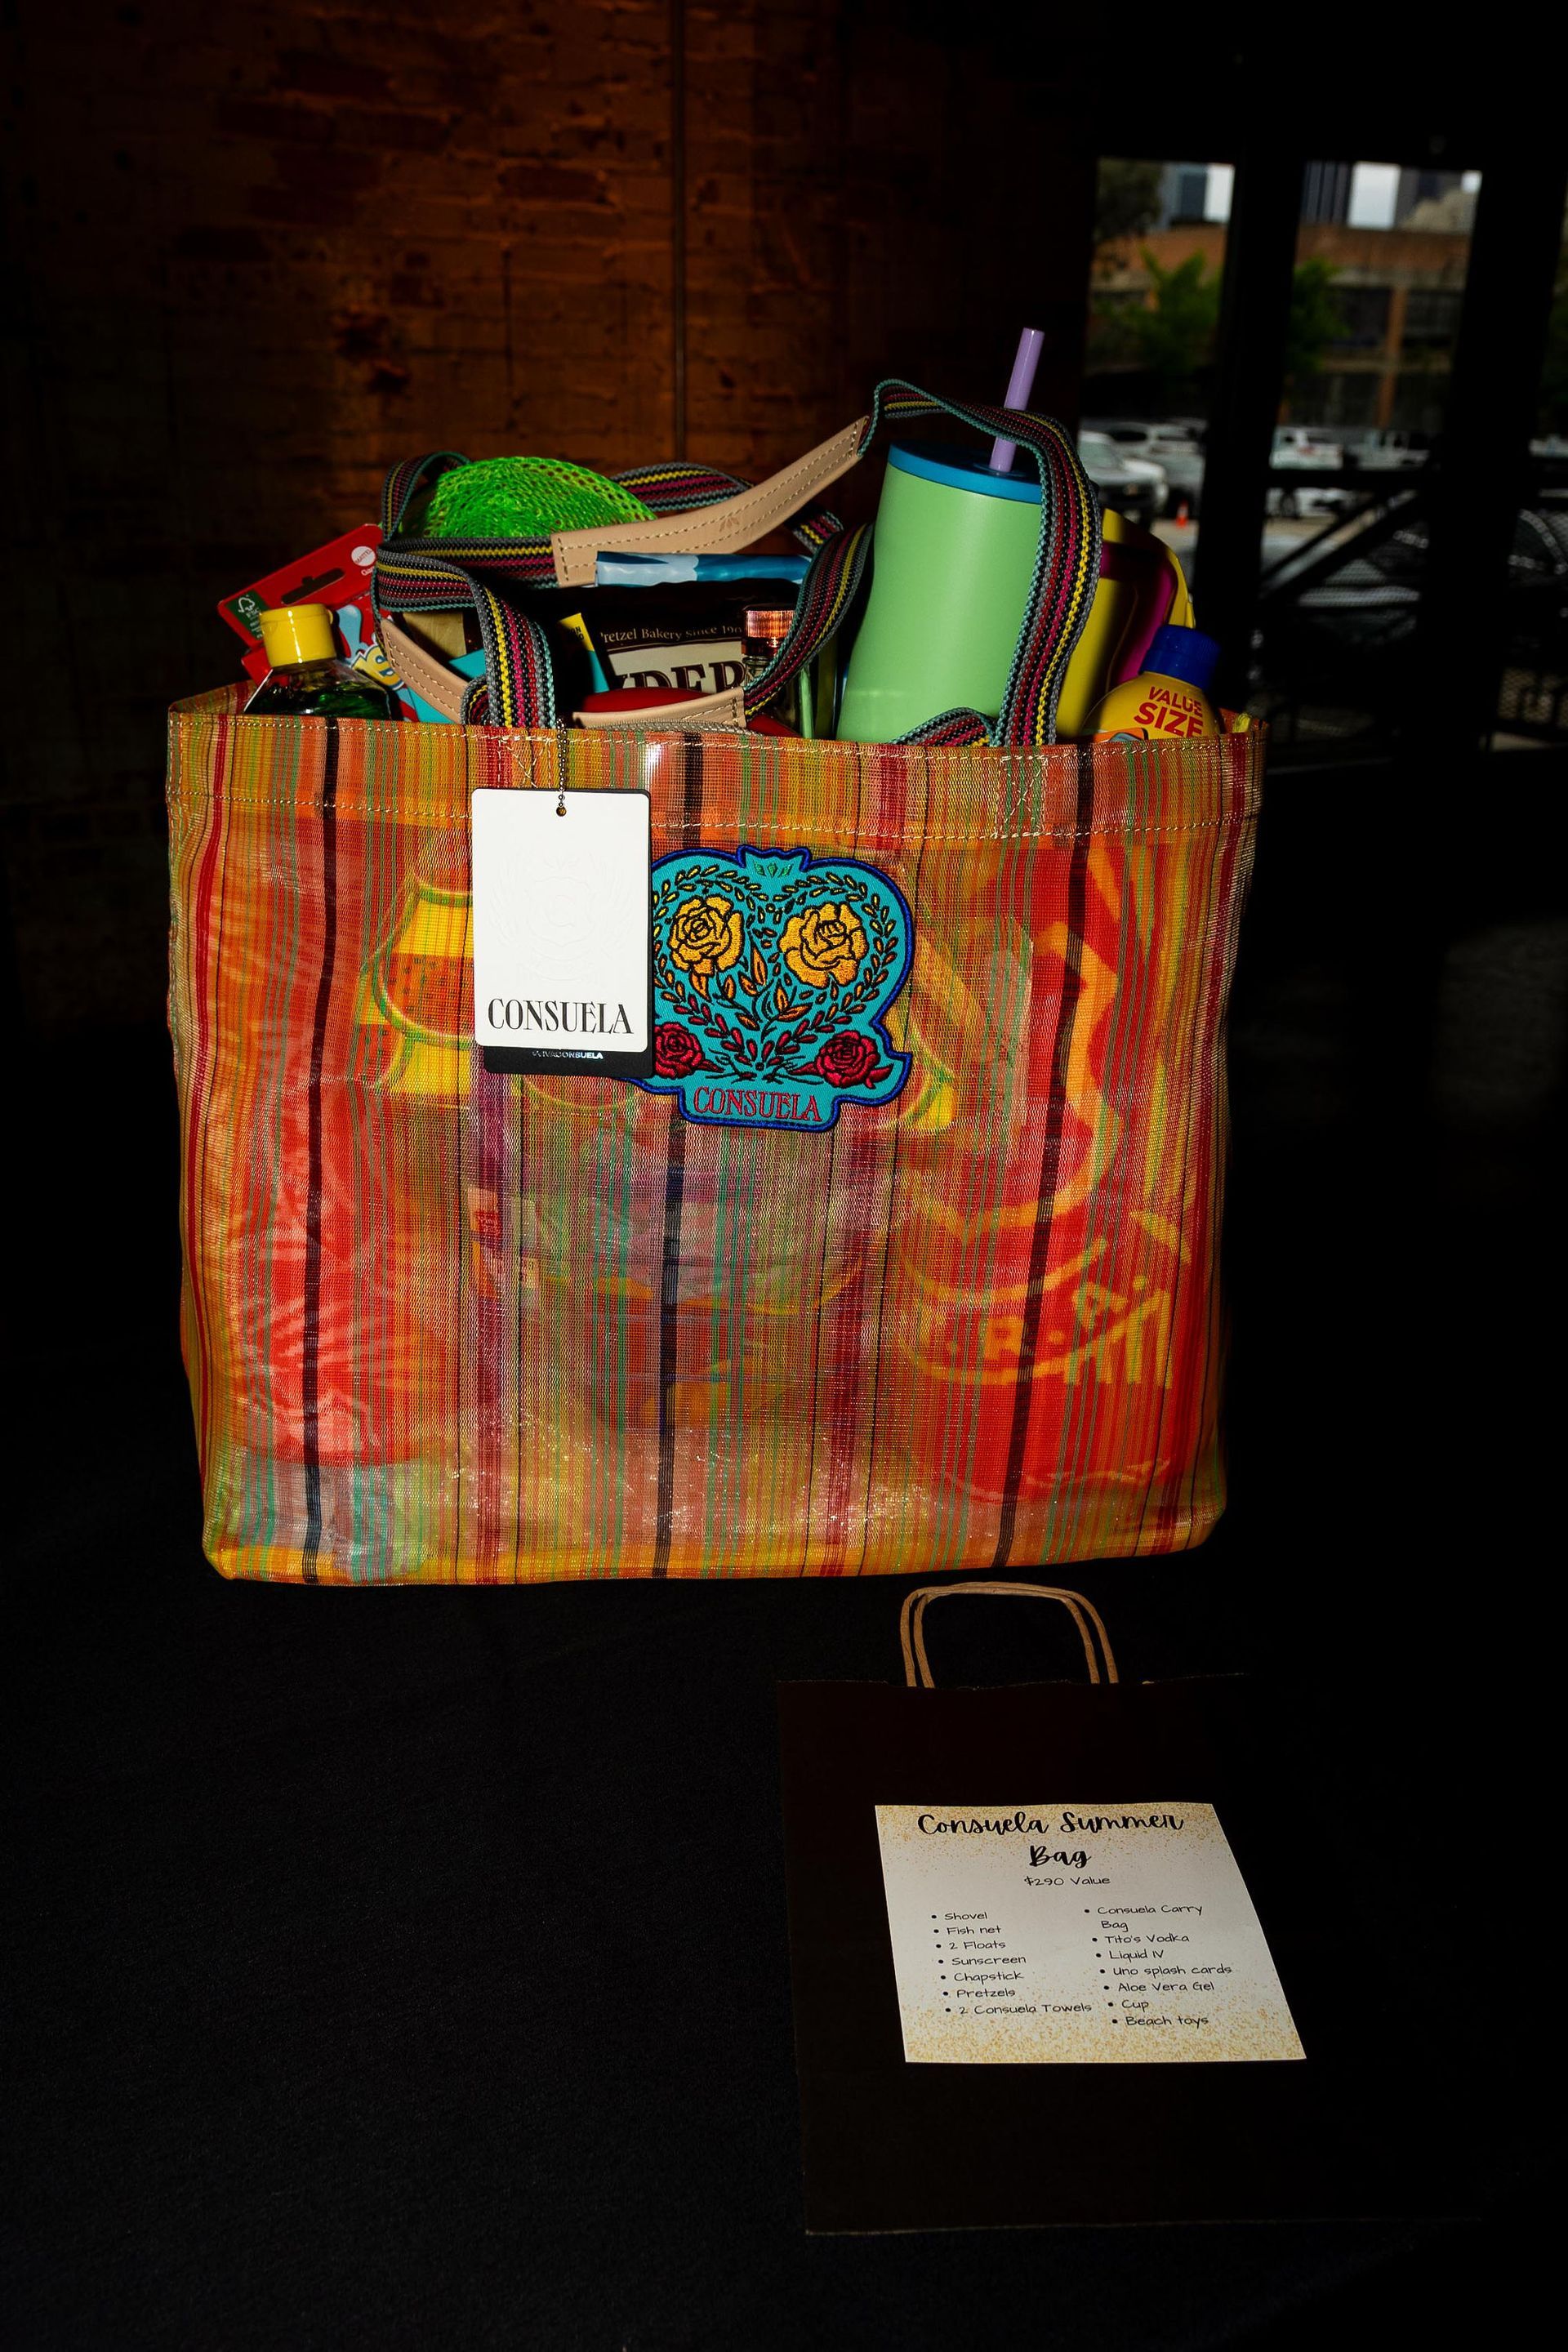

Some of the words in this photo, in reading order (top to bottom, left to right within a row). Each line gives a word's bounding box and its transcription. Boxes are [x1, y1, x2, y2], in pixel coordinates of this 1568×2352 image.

[600, 628, 637, 643] retzel
[641, 627, 682, 641] Bakery
[685, 626, 718, 637] since
[615, 659, 746, 693] DER
[1148, 686, 1203, 718] VALUE
[1134, 702, 1204, 737] SIZE
[488, 998, 635, 1035] CONSUELA
[693, 1086, 822, 1123] CONSUELA
[917, 1811, 1049, 1836] Consuela
[1059, 1811, 1185, 1834] Summer
[1028, 1845, 1092, 1869] Bag
[1023, 1875, 1064, 1886] $290
[1070, 1876, 1111, 1886] Value
[944, 1911, 988, 1921] Shovel
[1097, 1904, 1156, 1914] Consuela
[1160, 1904, 1203, 1916] Carry
[947, 1926, 975, 1935] Fish
[979, 1925, 1001, 1934] net
[1101, 1920, 1129, 1933] Bag
[1104, 1935, 1142, 1944] Tito's
[1146, 1932, 1190, 1943] Vodka
[948, 1942, 958, 1950] 2
[963, 1940, 1006, 1949] Floats
[951, 1956, 1027, 1966] Sunscreen
[1108, 1949, 1148, 1962] Liquid
[1152, 1949, 1164, 1959] IV
[954, 1970, 1023, 1984] Chapstick
[1143, 1965, 1187, 1979] splash
[1191, 1962, 1232, 1974] cards
[956, 1987, 1016, 1998] Pretzels
[1118, 1982, 1147, 1992] Aloe
[1152, 1982, 1188, 1992] Vera
[1192, 1981, 1215, 1992] Gel
[960, 2007, 969, 2015] 2
[973, 2003, 1037, 2015] Consuela
[1041, 2002, 1092, 2013] Towels
[1121, 1999, 1149, 2012] Cup
[1125, 2016, 1173, 2026] Beach
[1177, 2015, 1209, 2029] toys
